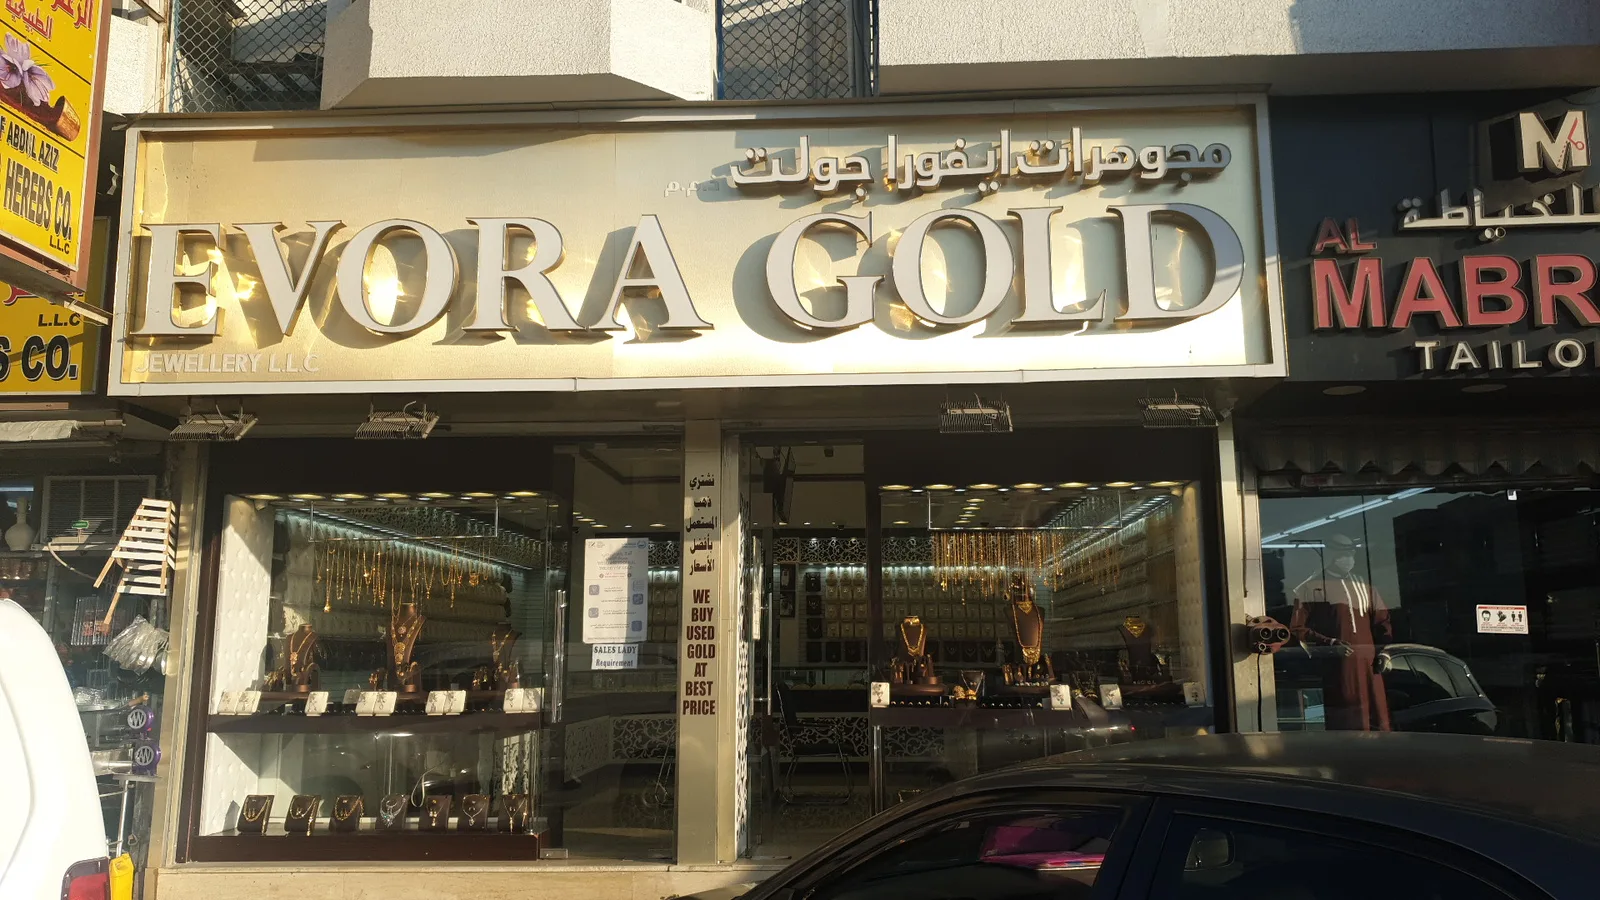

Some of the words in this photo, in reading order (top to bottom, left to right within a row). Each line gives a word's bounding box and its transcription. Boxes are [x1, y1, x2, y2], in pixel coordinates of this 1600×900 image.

[6, 121, 37, 161] ABDUL
[38, 140, 60, 173] AZIZ
[1518, 110, 1592, 172] M
[1016, 126, 1232, 184] مجوهرات
[729, 134, 875, 202] جولت
[4, 157, 53, 231] HEREBS
[54, 186, 72, 242] CO.
[1396, 182, 1600, 240] لخياطة
[49, 234, 70, 255] L.L.C
[1311, 216, 1378, 254] AL
[130, 213, 714, 338] EVORA
[765, 201, 1245, 330] GOLD
[38, 313, 81, 327] L.L.C
[21, 334, 78, 382] CO.
[135, 352, 261, 373] JEWELLERY
[268, 352, 320, 373] L.L.C
[1413, 338, 1600, 371] TAILO
[689, 472, 715, 490] نشتري
[693, 496, 712, 511] ذهب
[685, 516, 718, 533] المستعمل
[689, 534, 713, 555] بأفضل
[688, 555, 715, 576] الأسعار
[692, 589, 711, 604] WE
[691, 607, 714, 622] BUY
[686, 625, 715, 640] USED
[593, 645, 616, 654] SALES
[617, 645, 638, 654] LADY
[687, 643, 716, 659] GOLD
[595, 658, 634, 668] Requirement
[694, 662, 708, 677] AT
[685, 680, 713, 696] BEST
[682, 700, 716, 715] PRICE
